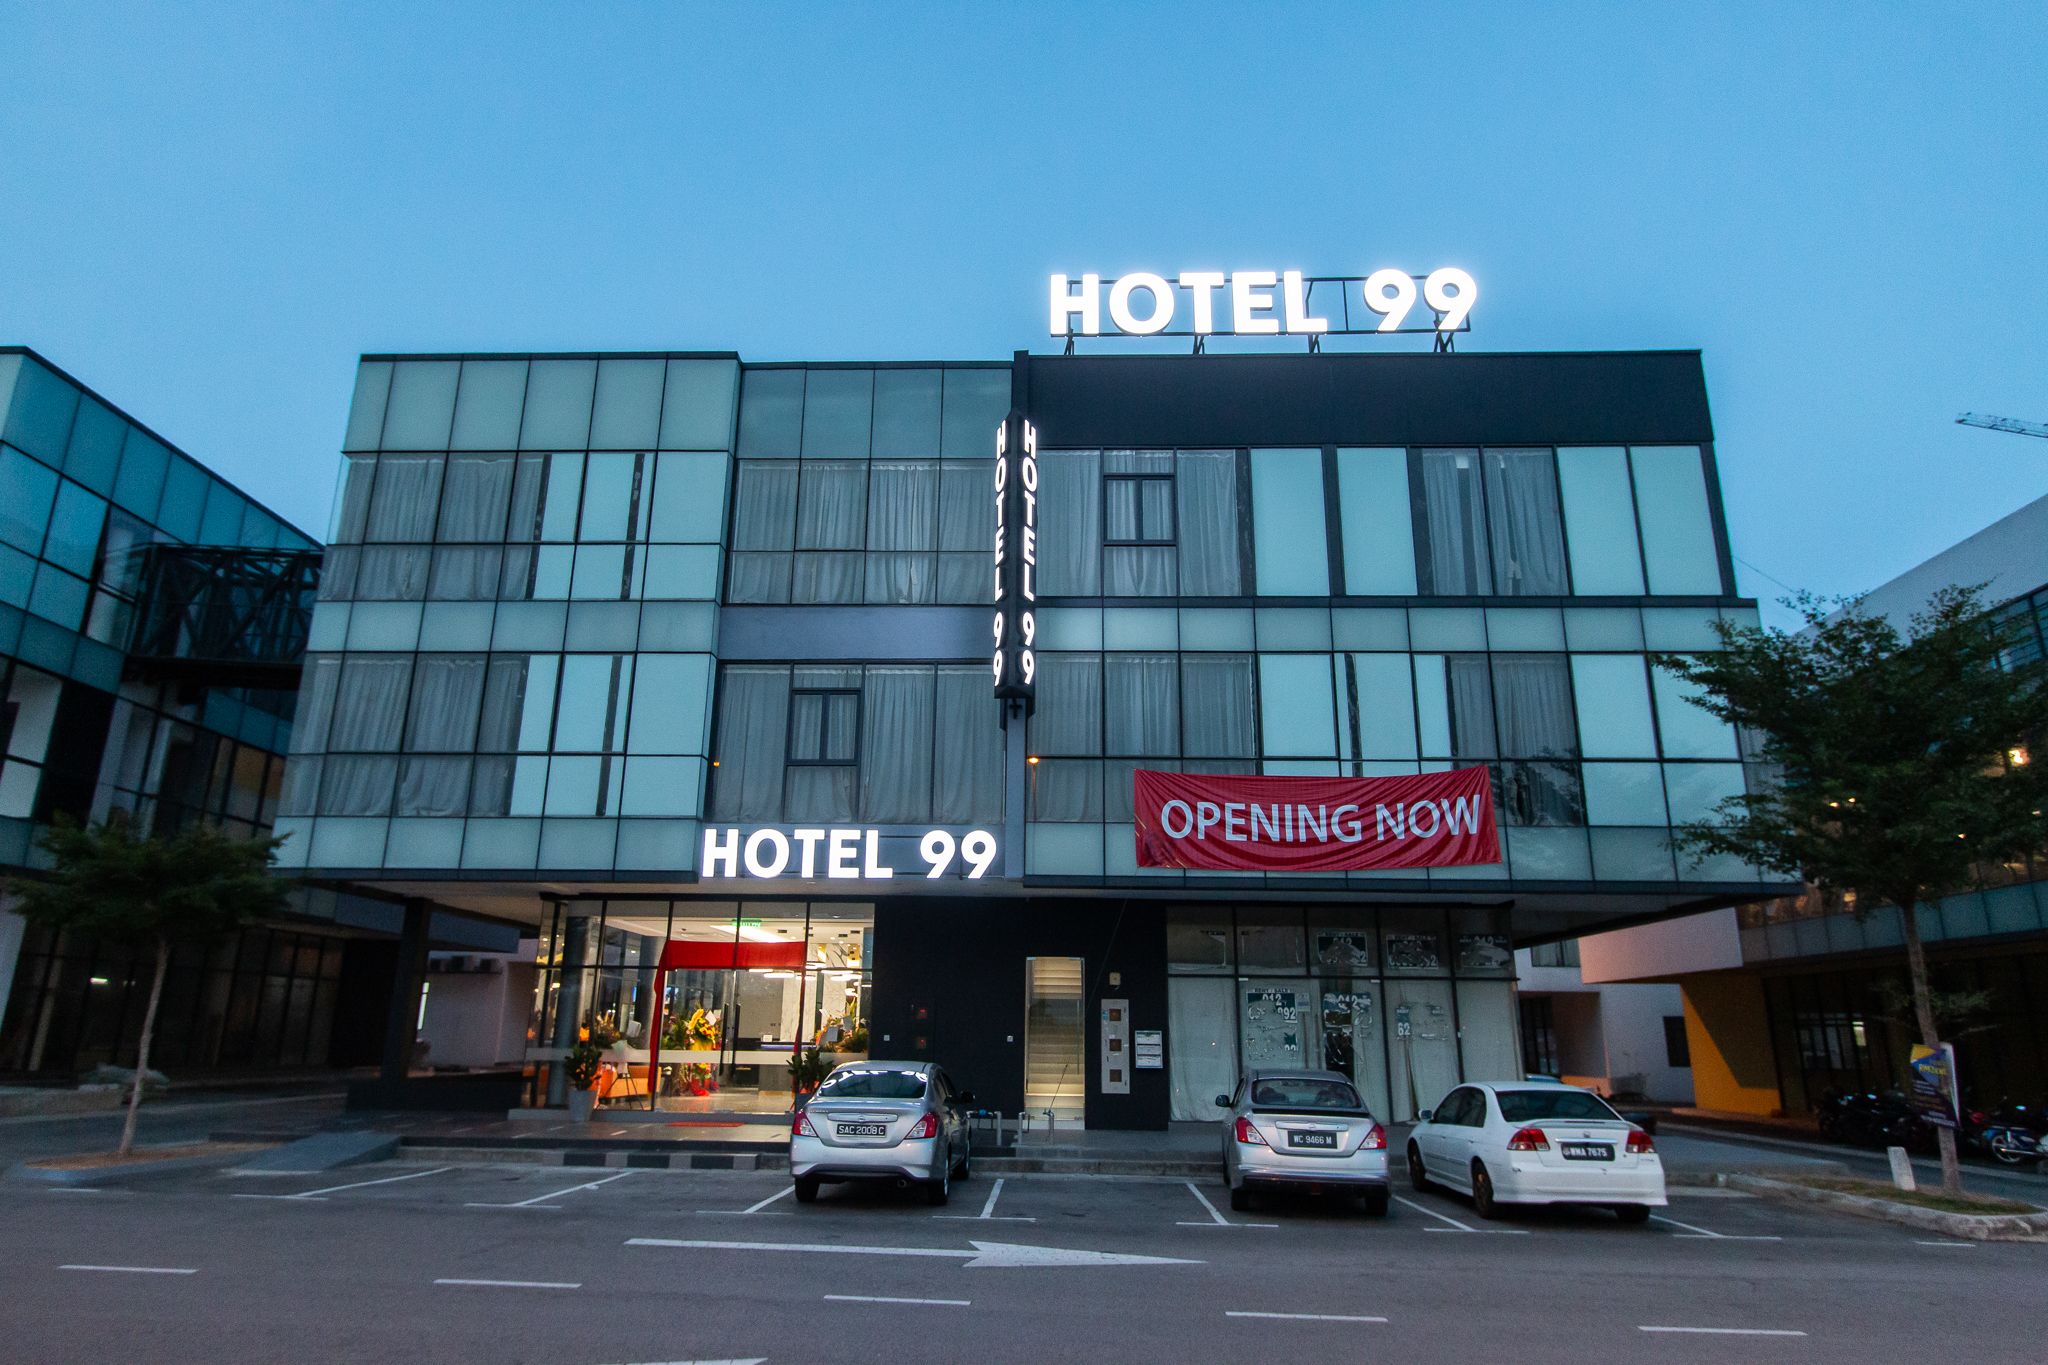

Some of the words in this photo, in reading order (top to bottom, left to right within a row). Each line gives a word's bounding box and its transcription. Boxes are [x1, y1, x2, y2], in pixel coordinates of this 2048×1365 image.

[1051, 270, 1328, 335] HOTEL
[1363, 267, 1478, 333] 99
[995, 419, 1007, 602] HOTEL
[1022, 419, 1038, 602] HOTEL
[993, 611, 1003, 687] 99
[1022, 611, 1035, 685] 99
[1160, 798, 1363, 843] OPENING
[1375, 794, 1481, 841] NOW
[702, 828, 893, 879] HOTEL
[920, 829, 997, 879] 99
[838, 1125, 855, 1134] SAC
[855, 1126, 878, 1135] 2008
[878, 1126, 885, 1135] C
[1293, 1134, 1303, 1144] WC
[1305, 1135, 1325, 1145] 9466
[1325, 1136, 1332, 1145] M
